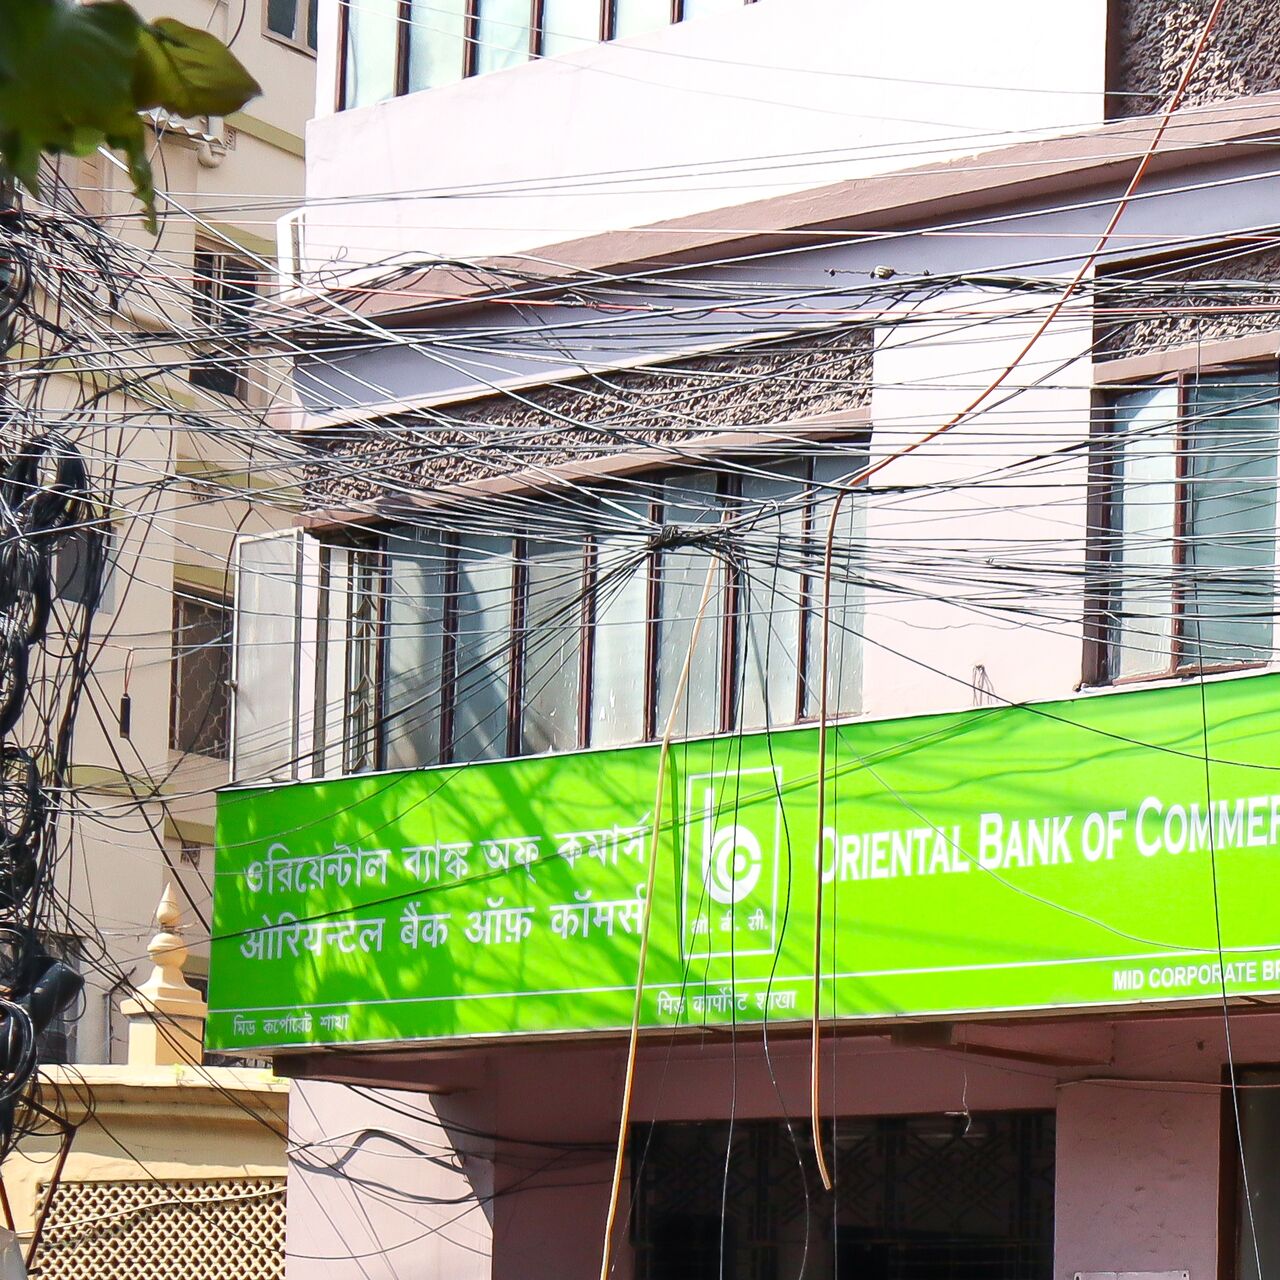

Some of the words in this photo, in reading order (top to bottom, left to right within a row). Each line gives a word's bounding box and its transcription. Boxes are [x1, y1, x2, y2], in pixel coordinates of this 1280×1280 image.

[246, 842, 392, 895] ওরিয়েন্টাল
[401, 839, 473, 880] ব্যাঙ্ক
[554, 811, 651, 870] কমার্স
[814, 825, 970, 884] ORIENTAL
[978, 811, 1073, 871] BANK
[239, 912, 387, 960] ओरियन्टल
[399, 902, 451, 949] बैंक
[549, 882, 648, 939] कॉमर्स
[1113, 969, 1144, 992] MID
[1148, 961, 1257, 988] CORPORATE
[233, 1014, 256, 1036] মিড
[320, 1013, 349, 1031] শাখা
[657, 990, 685, 1016] मिड
[755, 990, 797, 1011] शाखा
